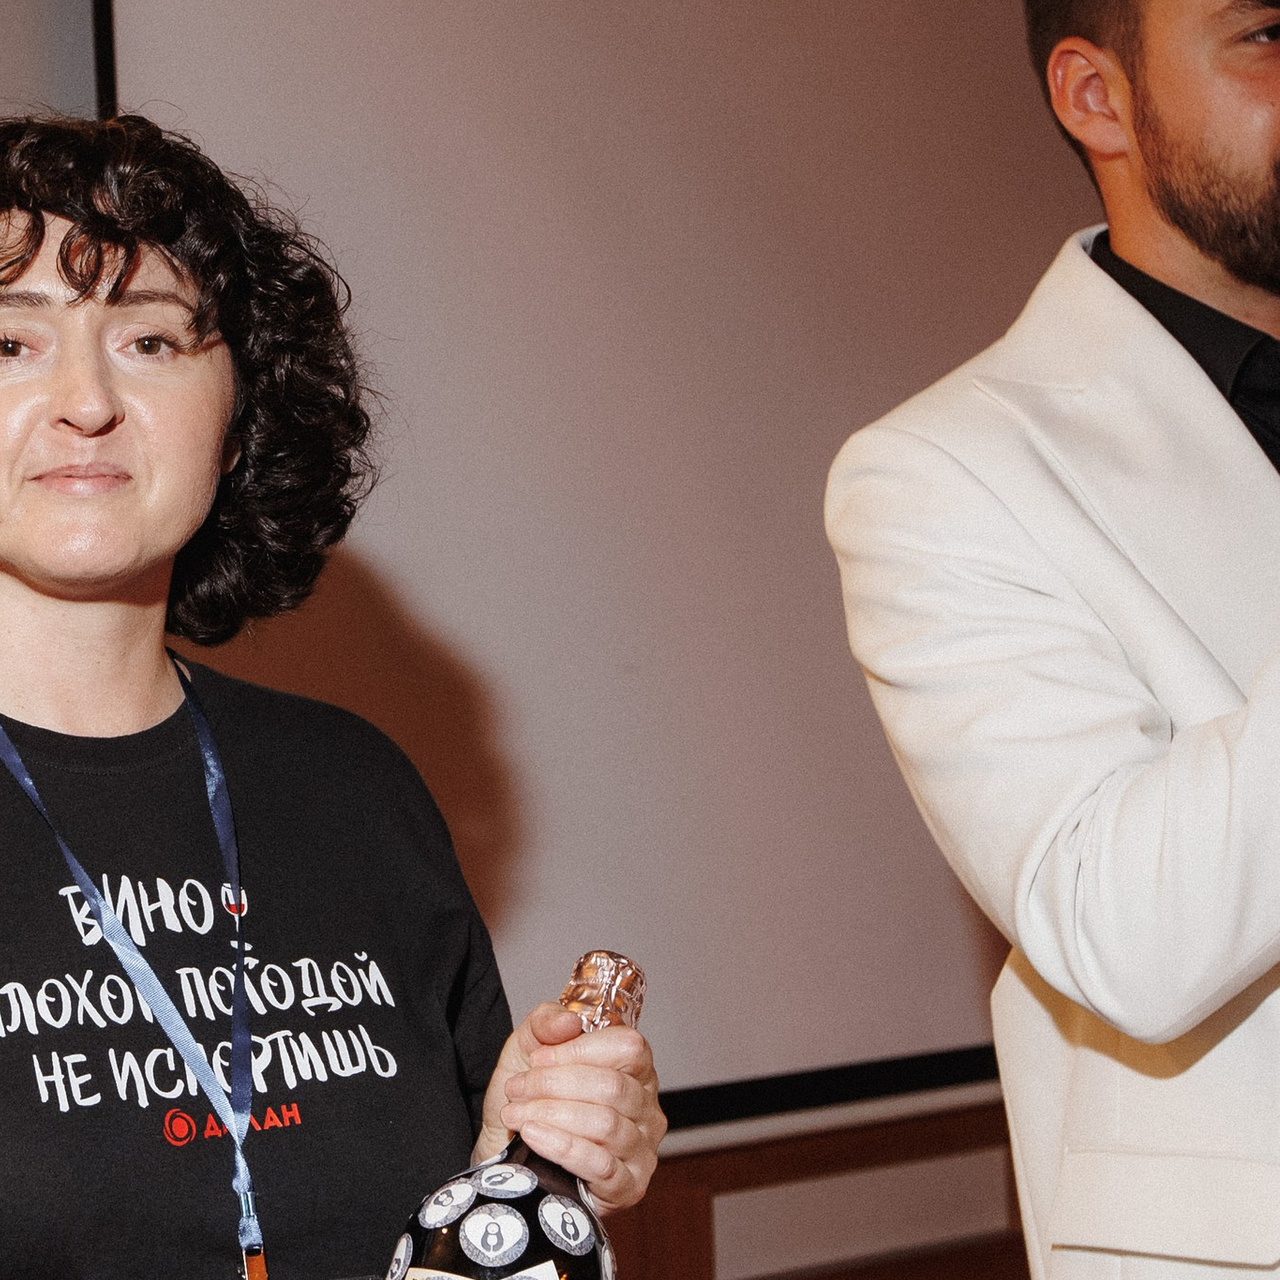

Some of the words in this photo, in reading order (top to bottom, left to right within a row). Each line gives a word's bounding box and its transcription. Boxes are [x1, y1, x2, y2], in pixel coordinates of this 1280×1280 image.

[58, 873, 215, 947] ВИНО
[32, 1051, 102, 1113] НЕ
[203, 1102, 302, 1139] ДАН
